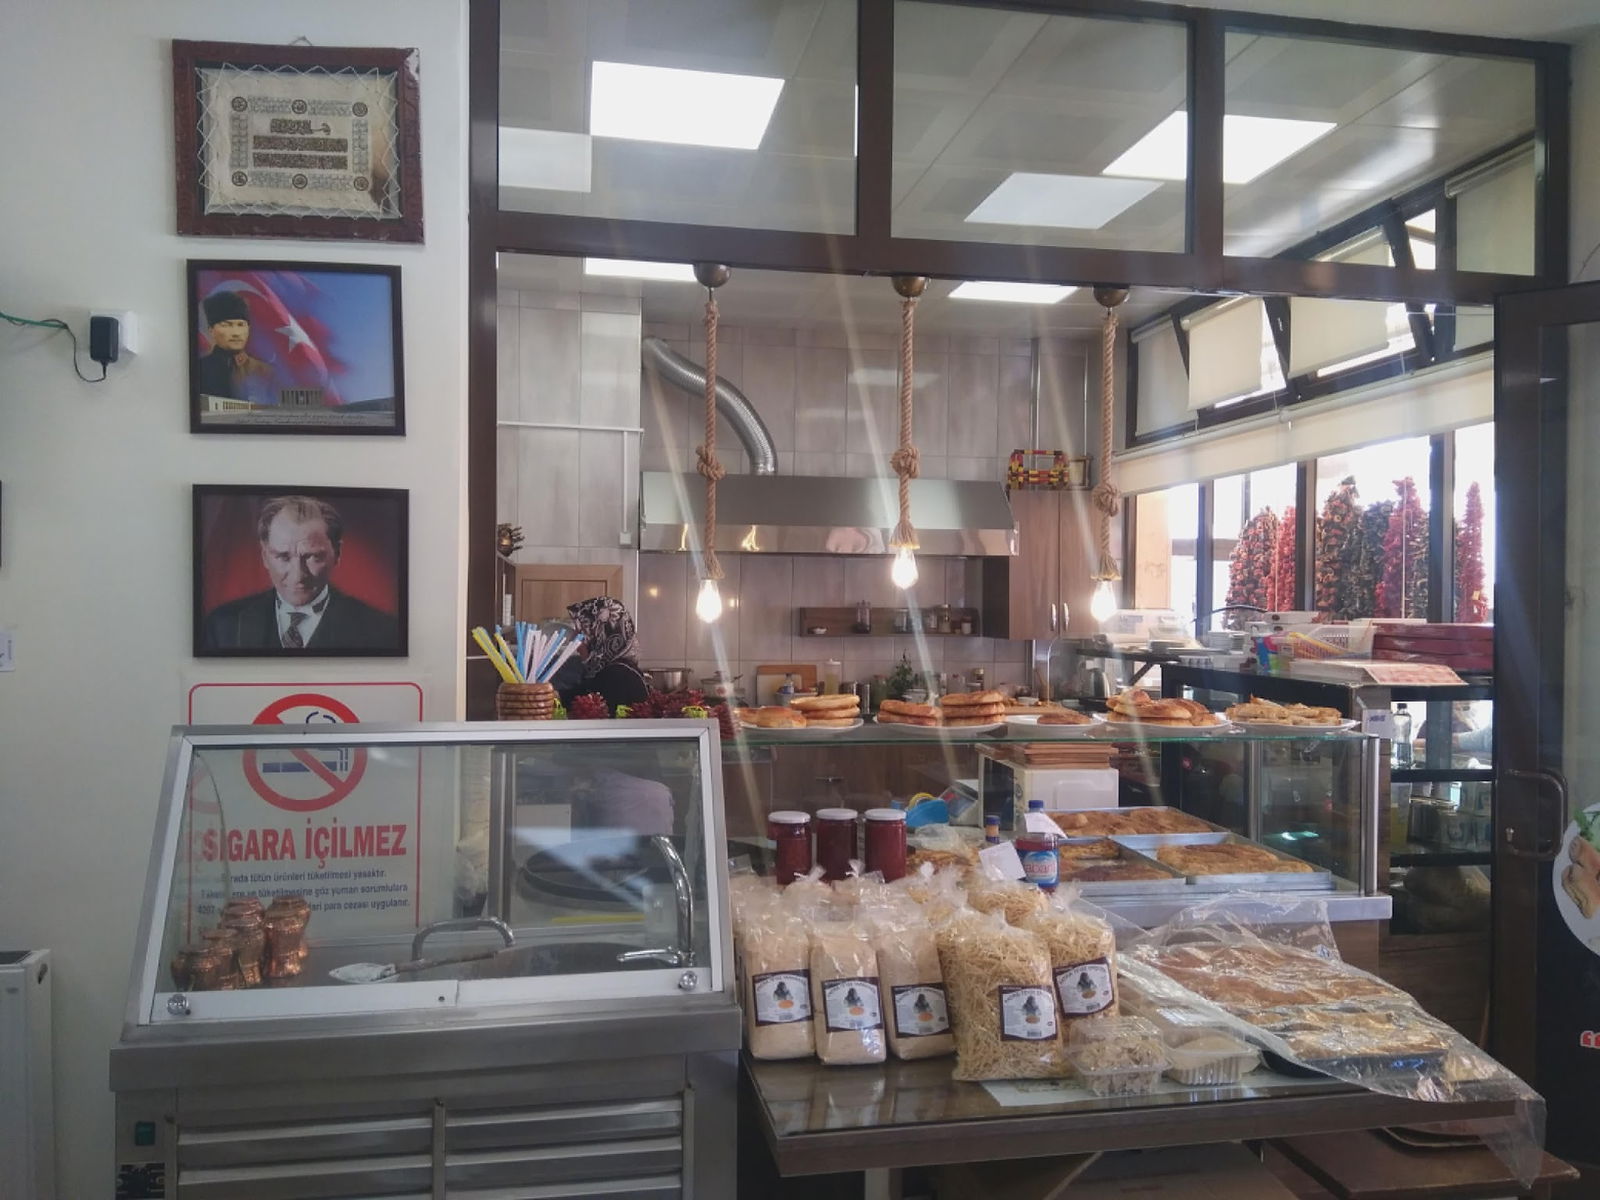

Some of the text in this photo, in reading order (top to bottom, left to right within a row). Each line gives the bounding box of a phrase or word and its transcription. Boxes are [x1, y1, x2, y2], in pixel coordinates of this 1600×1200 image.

[305, 817, 407, 869] İÇİLMEZ
[273, 871, 305, 882] ürünleri
[307, 869, 351, 881] tüketilmesi
[314, 887, 329, 898] göz
[331, 886, 359, 898] yuman
[324, 902, 342, 912] para
